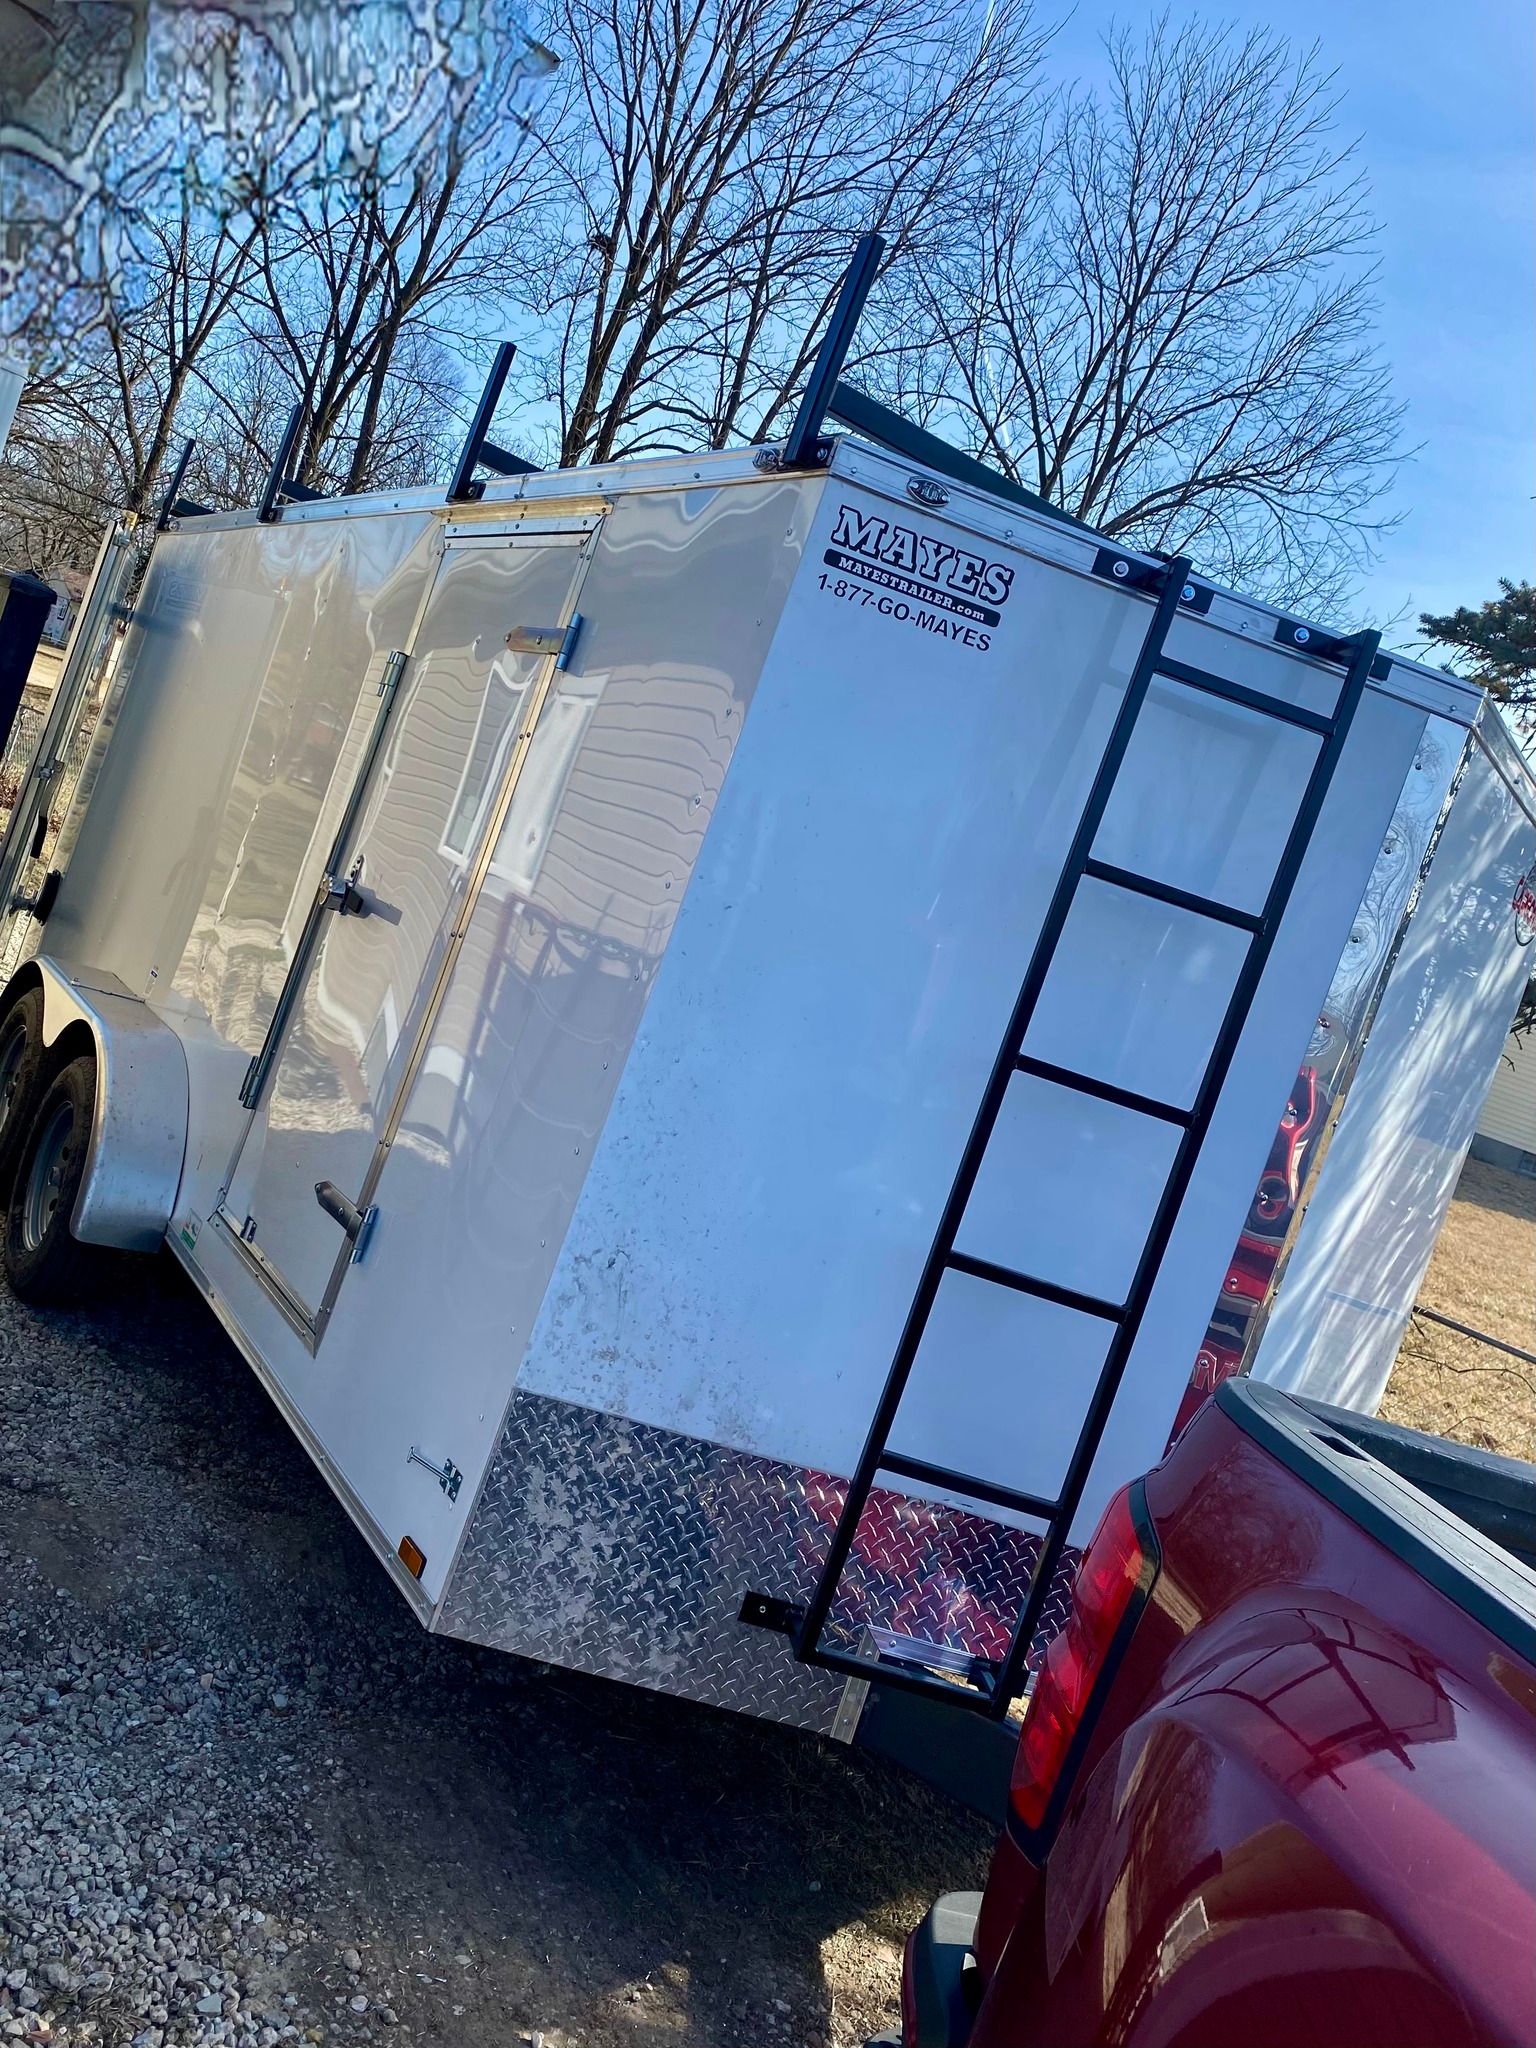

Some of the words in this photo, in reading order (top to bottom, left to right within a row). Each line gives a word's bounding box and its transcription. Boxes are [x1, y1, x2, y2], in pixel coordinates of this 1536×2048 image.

[831, 505, 1015, 606] MAYES
[838, 556, 985, 621] MAYESTRAILER.com
[818, 573, 992, 651] 1-877-GO-MAYES
